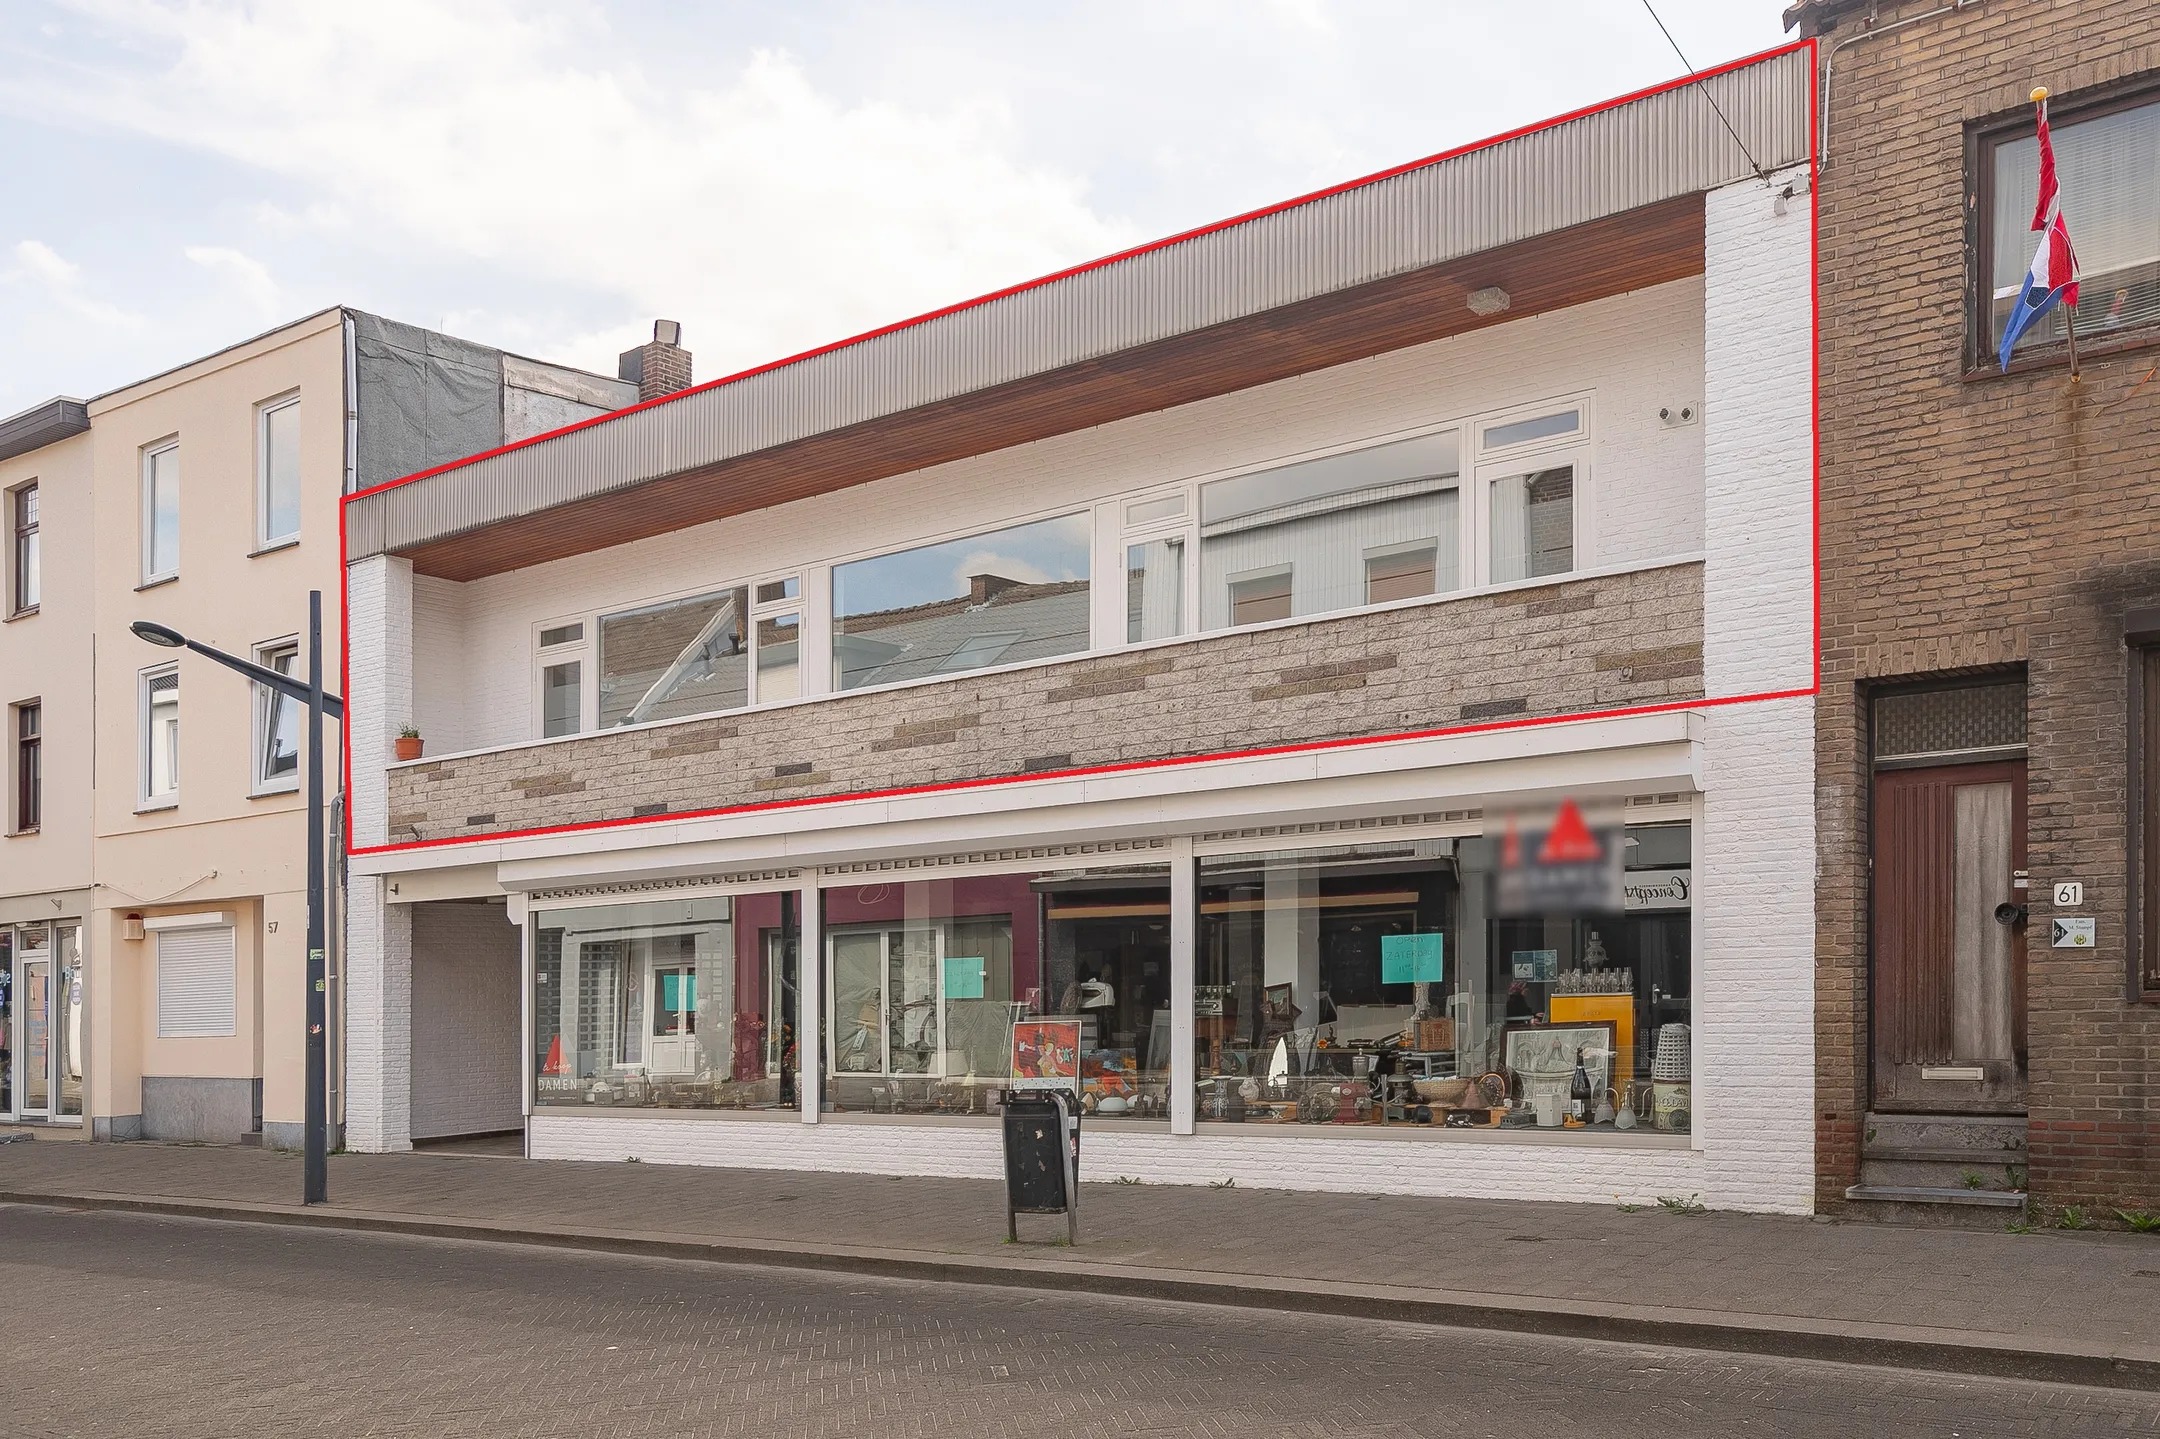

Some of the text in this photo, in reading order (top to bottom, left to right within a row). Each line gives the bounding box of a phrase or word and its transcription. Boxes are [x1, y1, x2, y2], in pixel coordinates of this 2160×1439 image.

[2058, 885, 2077, 903] 61
[268, 921, 279, 934] 57
[2054, 928, 2065, 938] 61
[538, 1078, 577, 1091] DAMEN
